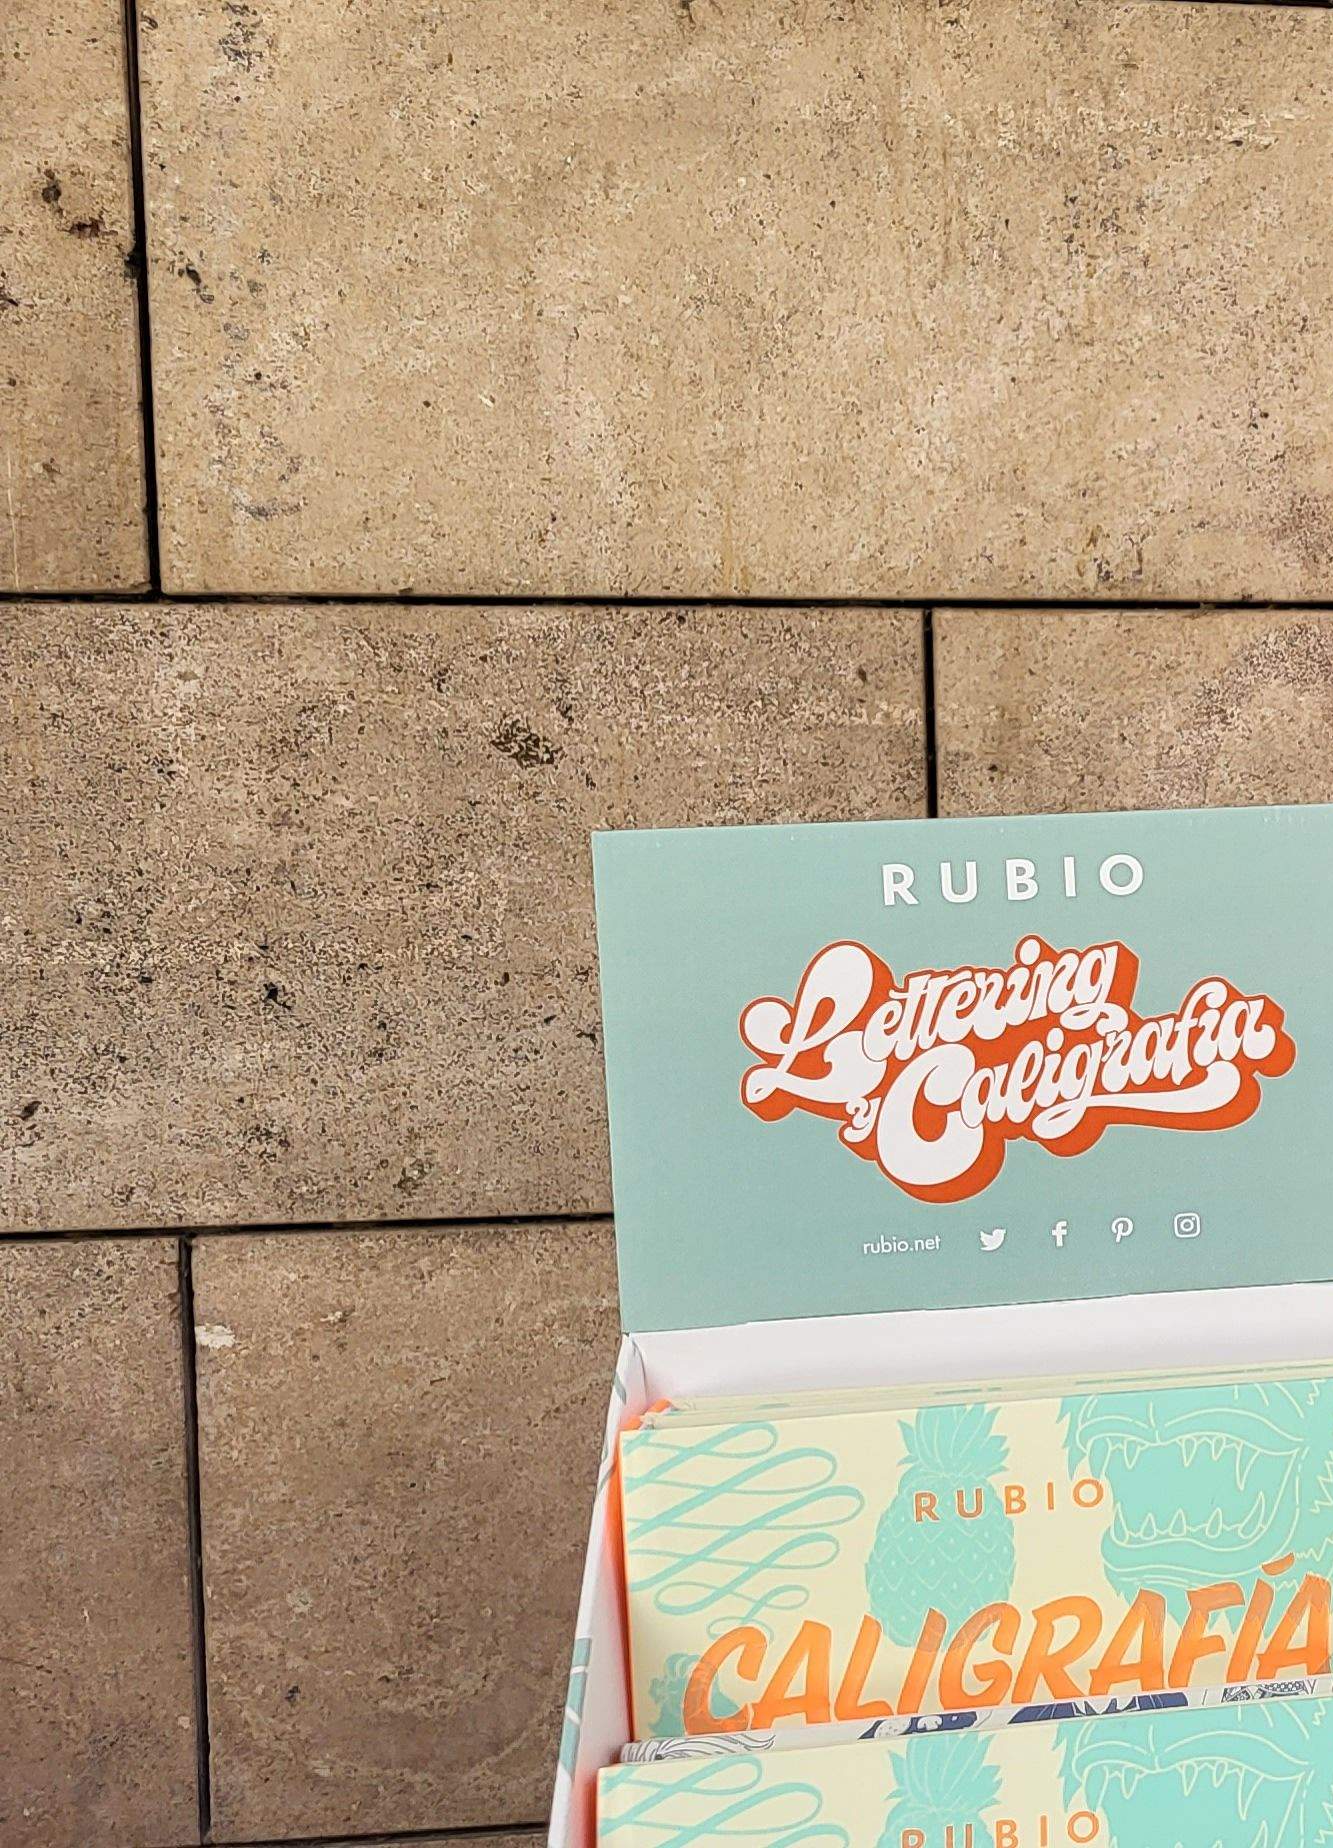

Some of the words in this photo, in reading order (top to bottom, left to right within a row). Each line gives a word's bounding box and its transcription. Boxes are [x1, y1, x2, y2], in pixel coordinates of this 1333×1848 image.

[881, 853, 1146, 907] RUBIO
[744, 938, 1118, 1104] Lettering
[861, 1233, 942, 1256] rubio.net
[913, 1478, 1106, 1523] RUBIO
[682, 1553, 1332, 1735] CALIGRAFÍA
[901, 1811, 1100, 1848] RUBIO
